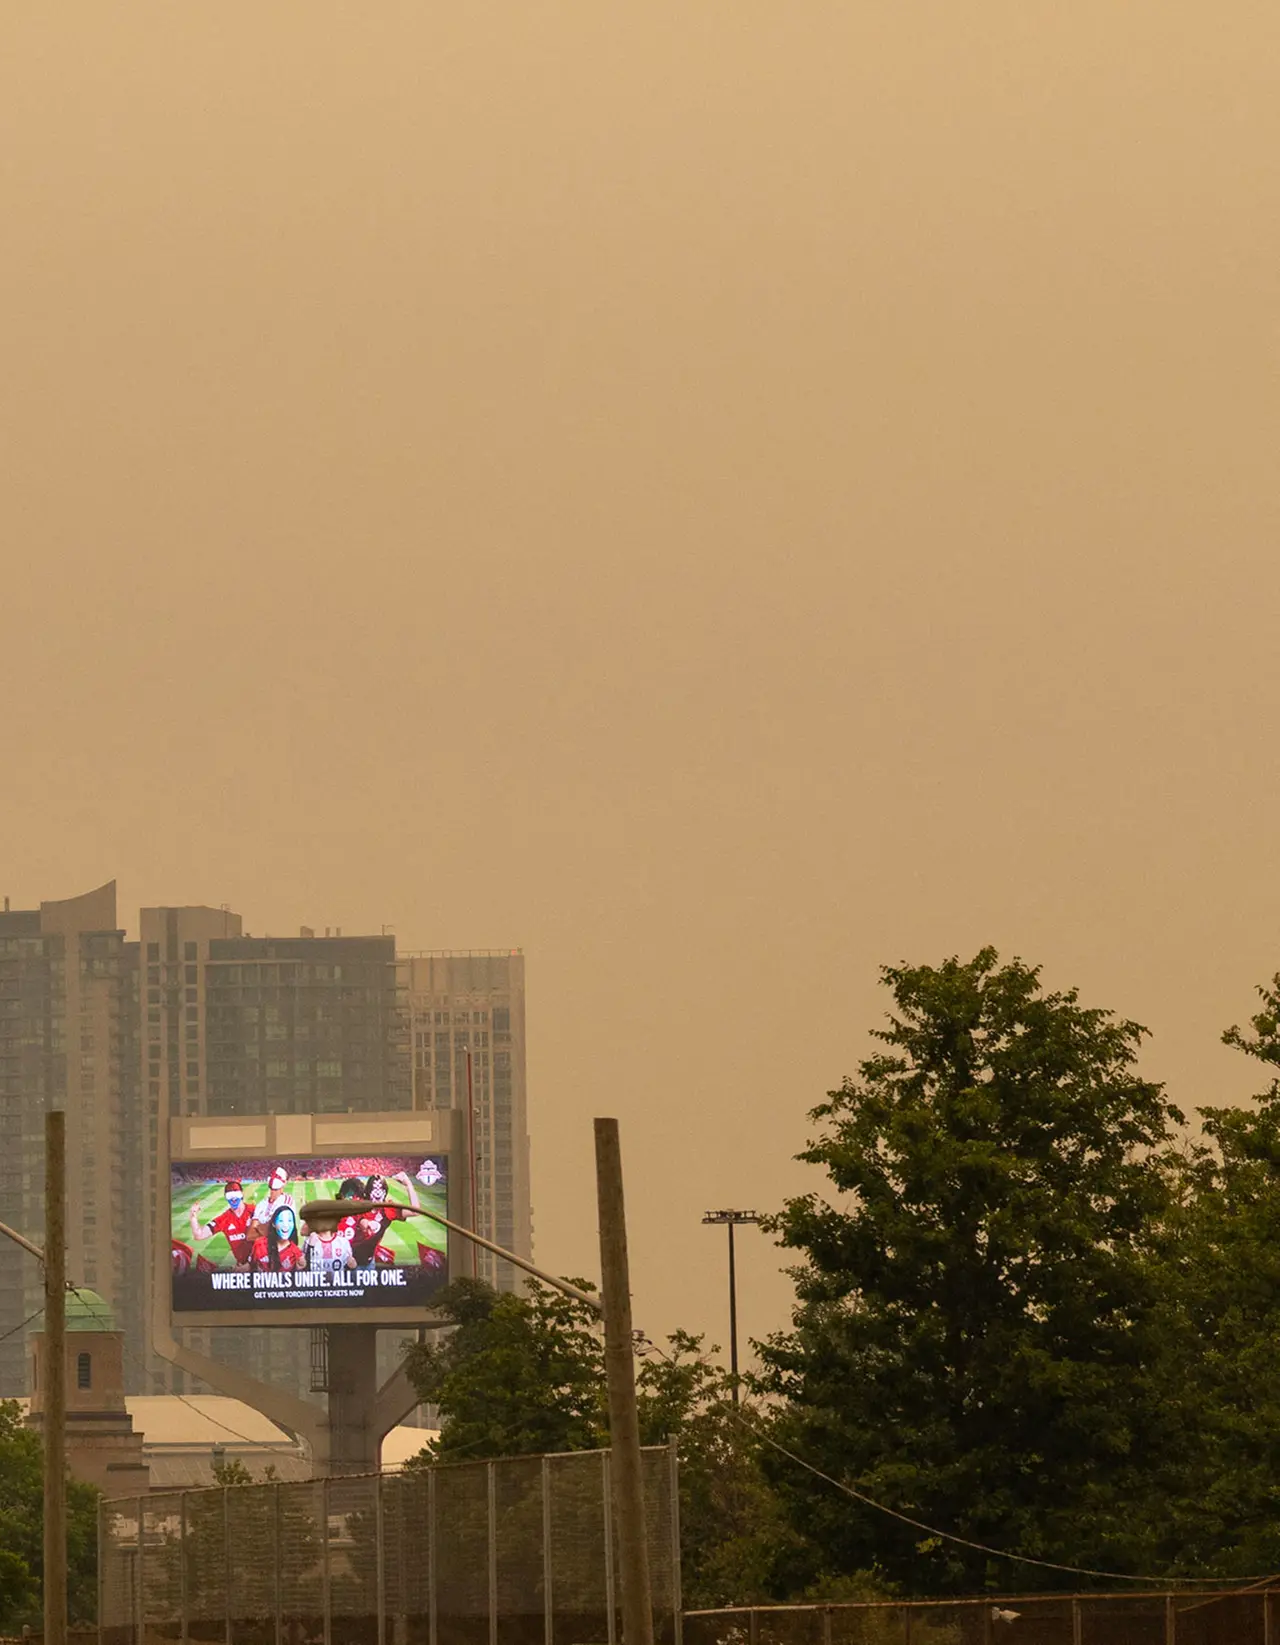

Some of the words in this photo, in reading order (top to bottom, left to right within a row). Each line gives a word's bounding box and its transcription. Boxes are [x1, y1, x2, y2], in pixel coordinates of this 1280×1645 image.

[211, 1273, 251, 1289] WHERE
[253, 1272, 292, 1288] RIVALS
[294, 1271, 330, 1287] UNITE.
[332, 1271, 354, 1287] ALL
[356, 1270, 378, 1286] FOR
[381, 1270, 407, 1286] ONE.
[254, 1291, 267, 1299] GET
[285, 1290, 313, 1298] TORONTO
[314, 1290, 323, 1298] FC
[349, 1289, 365, 1297] NOW
